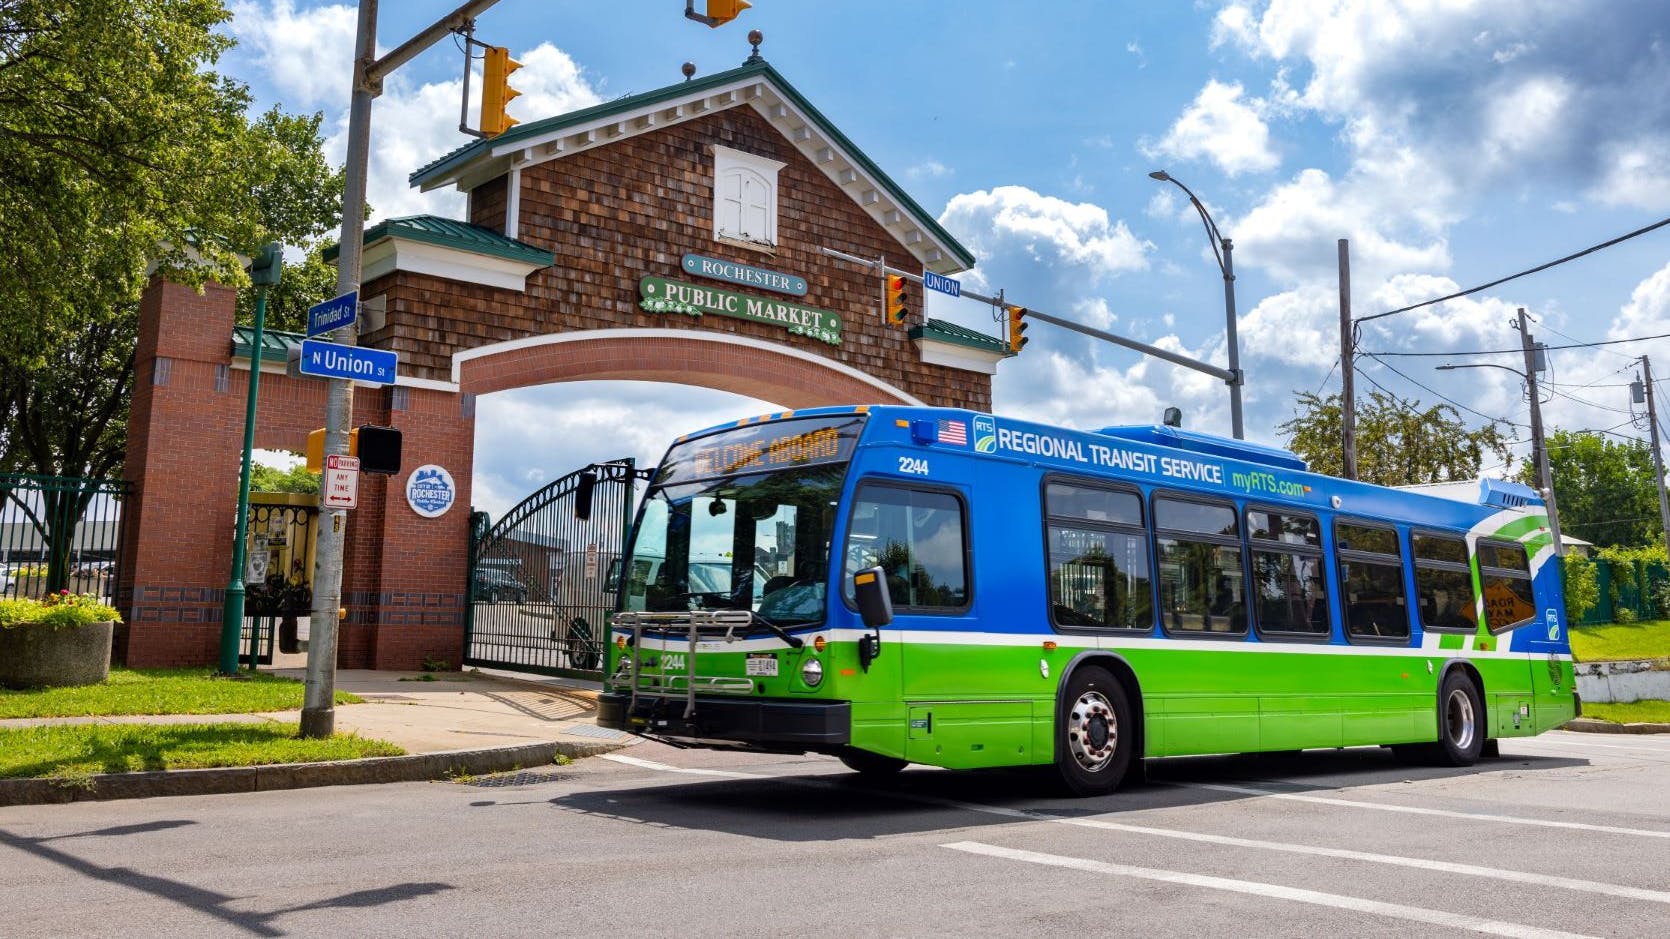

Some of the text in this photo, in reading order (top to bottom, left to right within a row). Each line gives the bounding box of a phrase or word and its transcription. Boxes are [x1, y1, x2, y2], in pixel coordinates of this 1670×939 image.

[702, 259, 790, 290] ROCHESTER
[926, 274, 959, 296] UNION
[314, 304, 350, 328] Trinidad St
[665, 283, 822, 328] PUBLIC MARKET
[313, 350, 385, 377] N Union St
[975, 421, 993, 433] RTS
[695, 427, 839, 473] WELCOME ABOARD
[998, 428, 1222, 484] REGIONAL TRANSIT SERVICE
[328, 457, 338, 468] NO
[898, 456, 929, 476] 2244
[334, 484, 349, 492] TIME
[336, 473, 349, 481] ANY
[1232, 471, 1305, 497] myRTS.com
[411, 488, 450, 502] ROCHESTER
